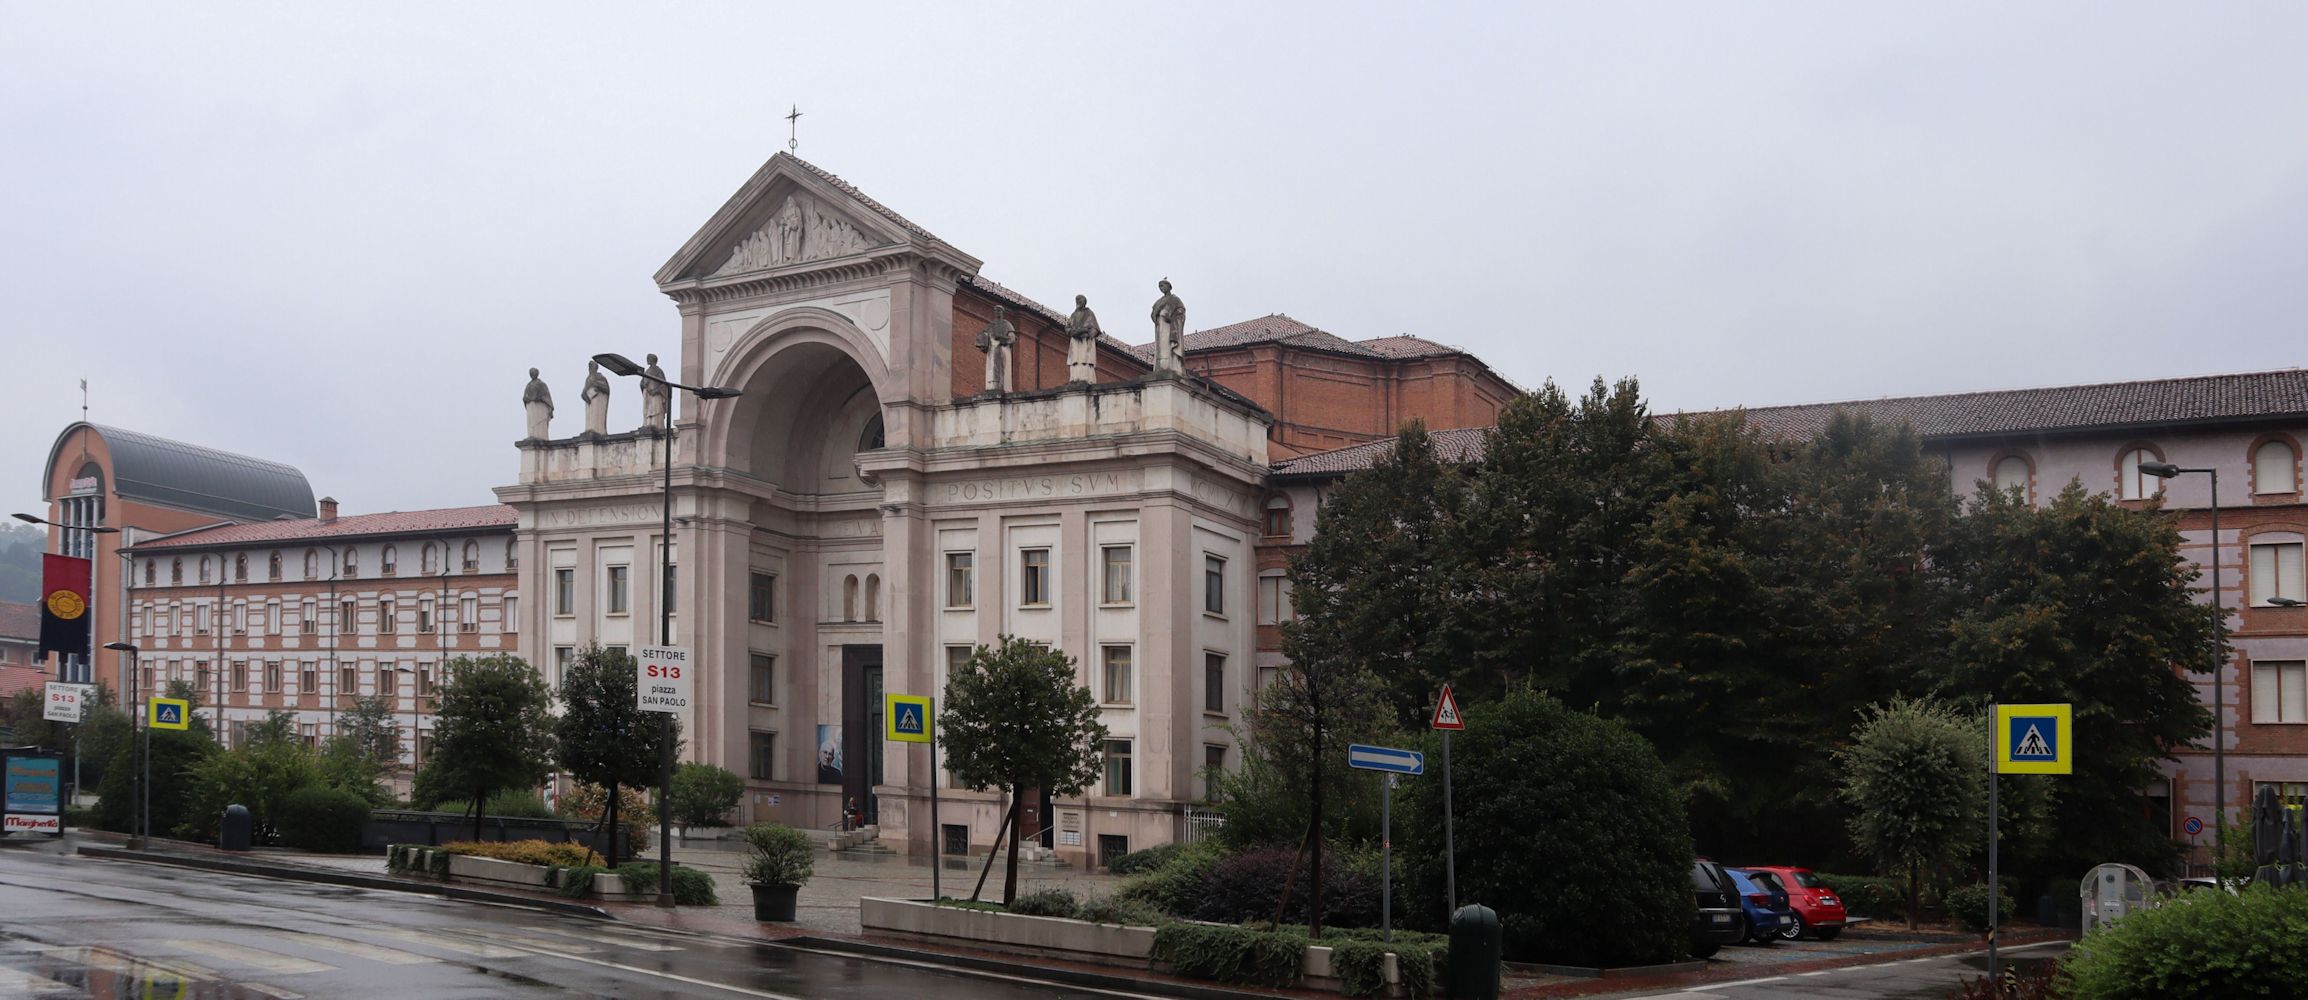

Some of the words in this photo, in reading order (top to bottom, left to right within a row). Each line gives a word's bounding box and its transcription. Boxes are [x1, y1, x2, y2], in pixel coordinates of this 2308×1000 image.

[947, 478, 1053, 503] POSITVS
[1071, 474, 1120, 494] SVM
[642, 648, 686, 661] SETTORE
[647, 665, 681, 679] S13
[651, 684, 676, 695] piazza
[51, 693, 75, 703] S13
[642, 696, 658, 705] SAN
[660, 697, 686, 707] PAOLO
